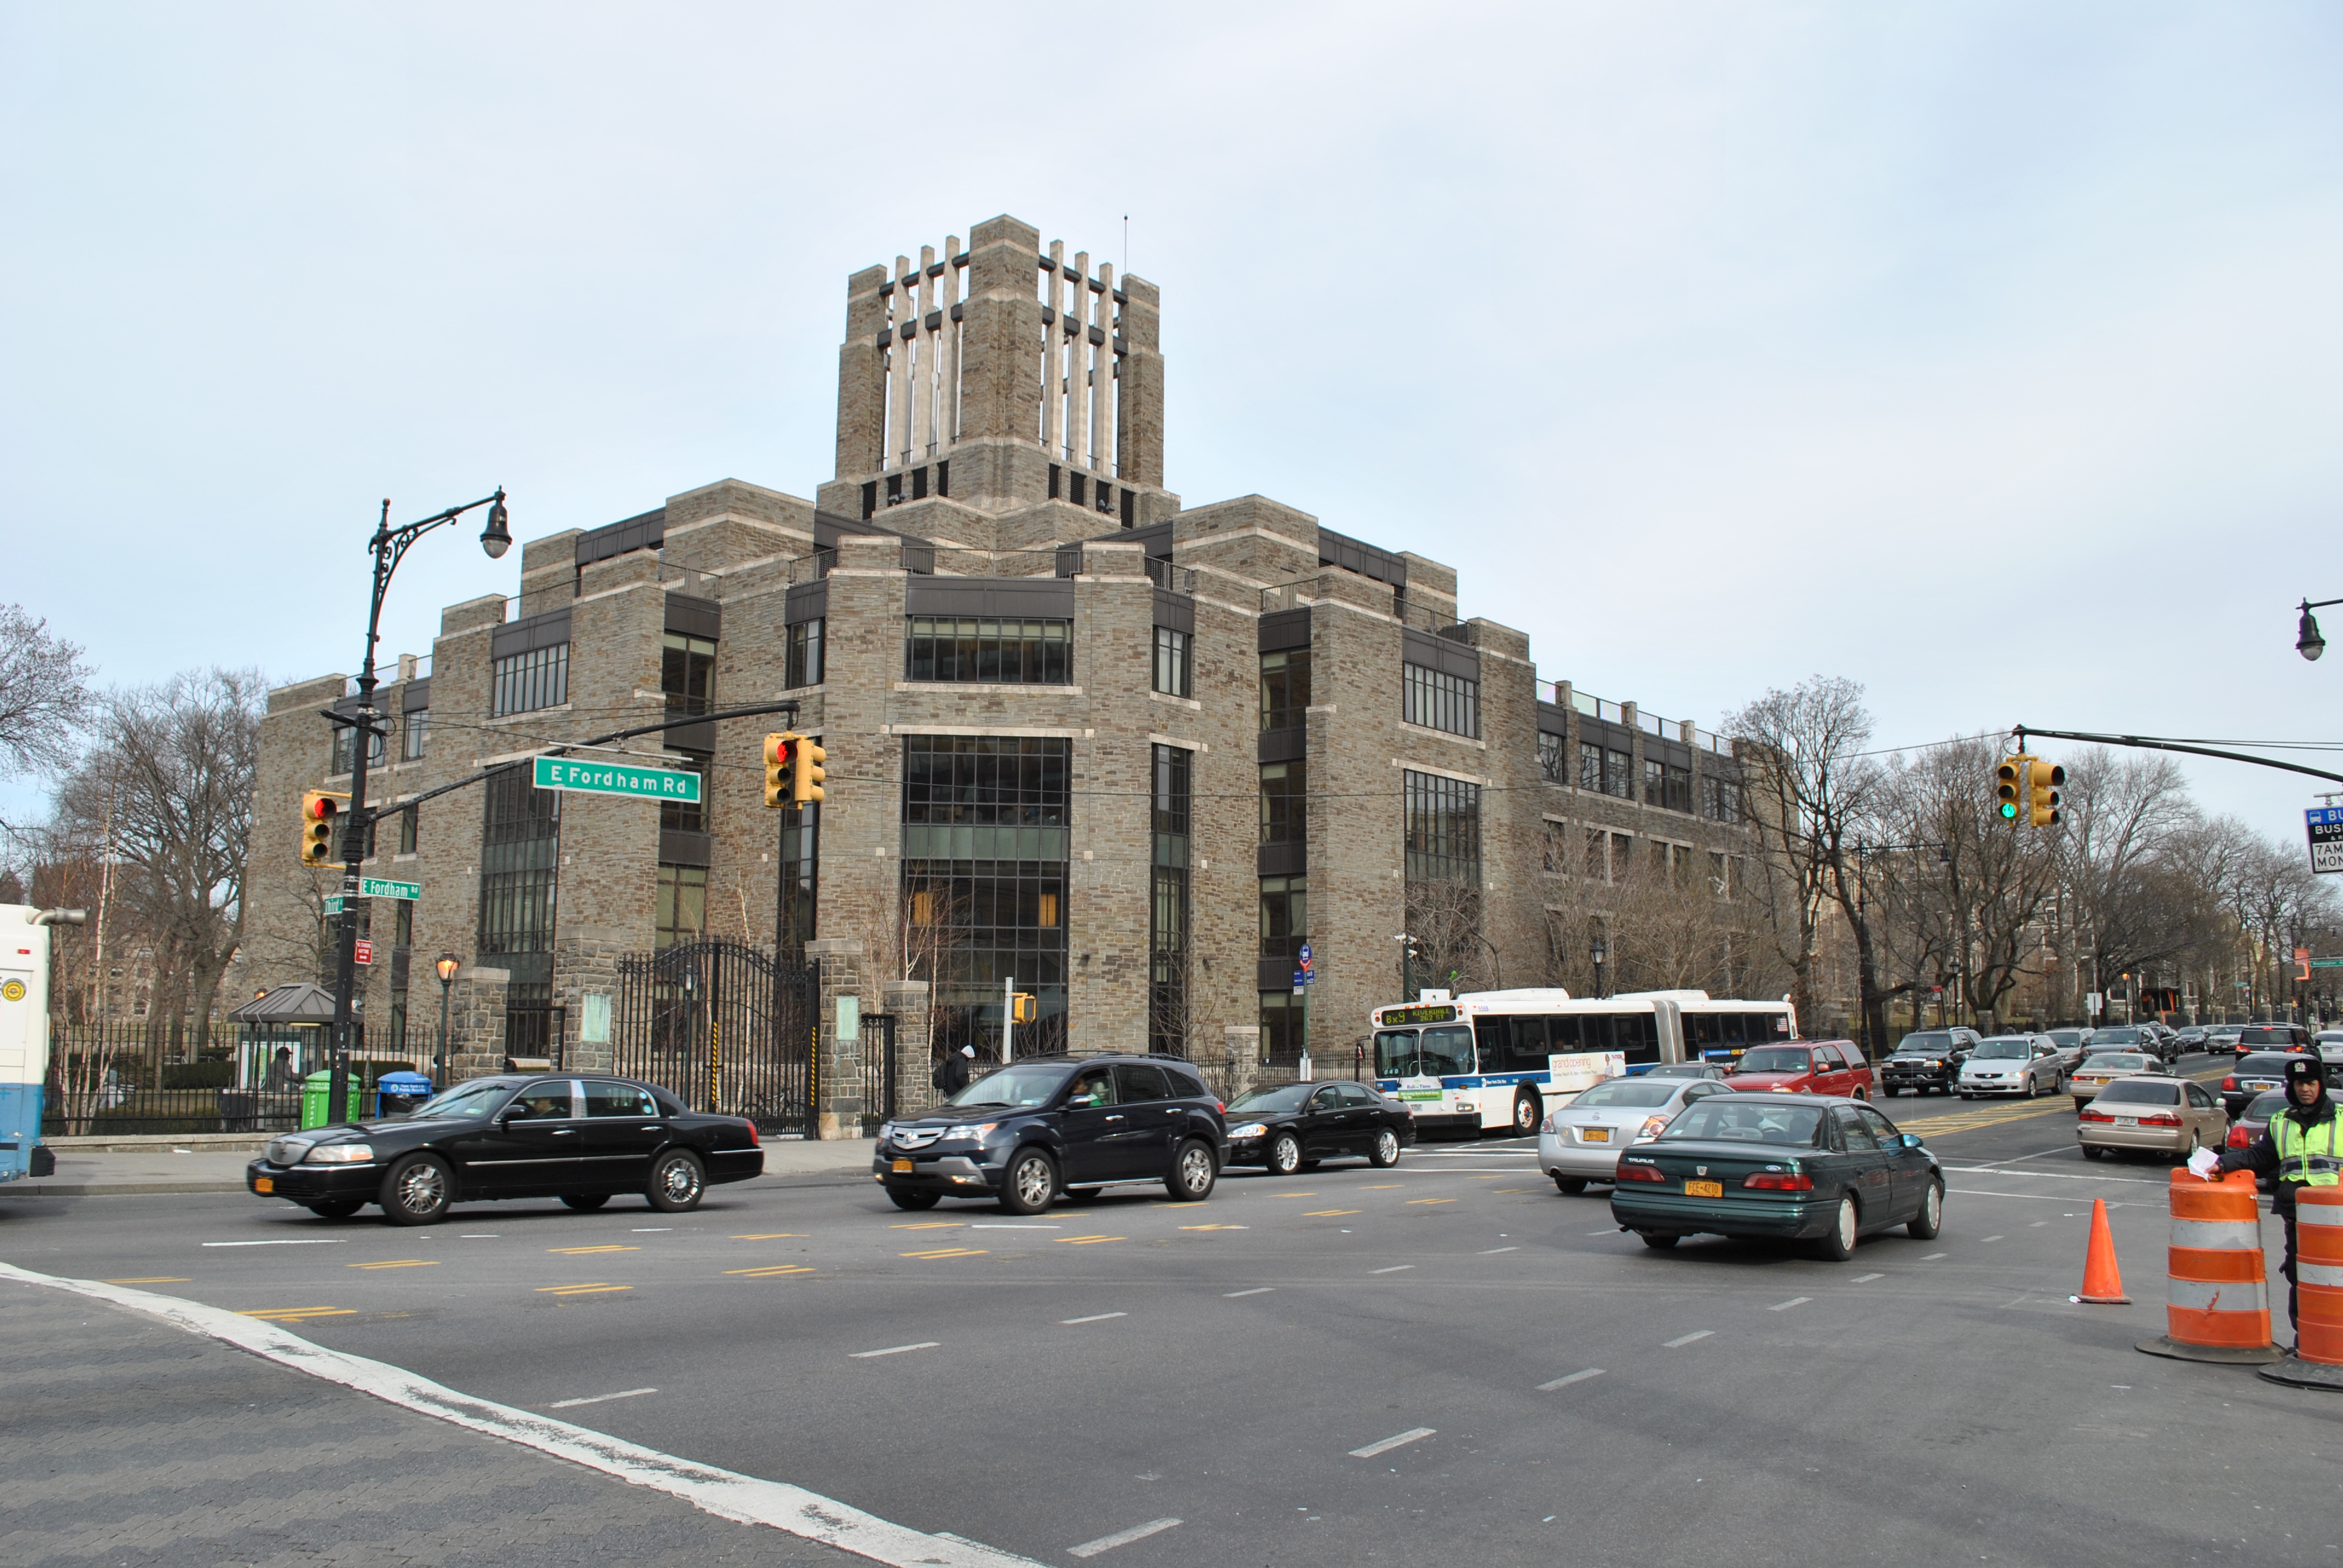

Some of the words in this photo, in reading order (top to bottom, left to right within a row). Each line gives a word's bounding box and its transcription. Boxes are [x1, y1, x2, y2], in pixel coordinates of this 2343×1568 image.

[551, 765, 562, 782] E
[569, 767, 657, 791] Fordham
[664, 777, 686, 794] Rd
[2315, 823, 2343, 834] BUS
[2315, 843, 2343, 855] 7AM
[362, 880, 368, 893] E
[371, 881, 408, 898] Fordham
[411, 886, 418, 894] Rd
[325, 898, 339, 913] Third
[1386, 1011, 1406, 1024] Bx9
[1412, 1007, 1450, 1016] RIVERDALE
[1552, 1057, 1569, 1071] grand
[1570, 1056, 1591, 1069] opening
